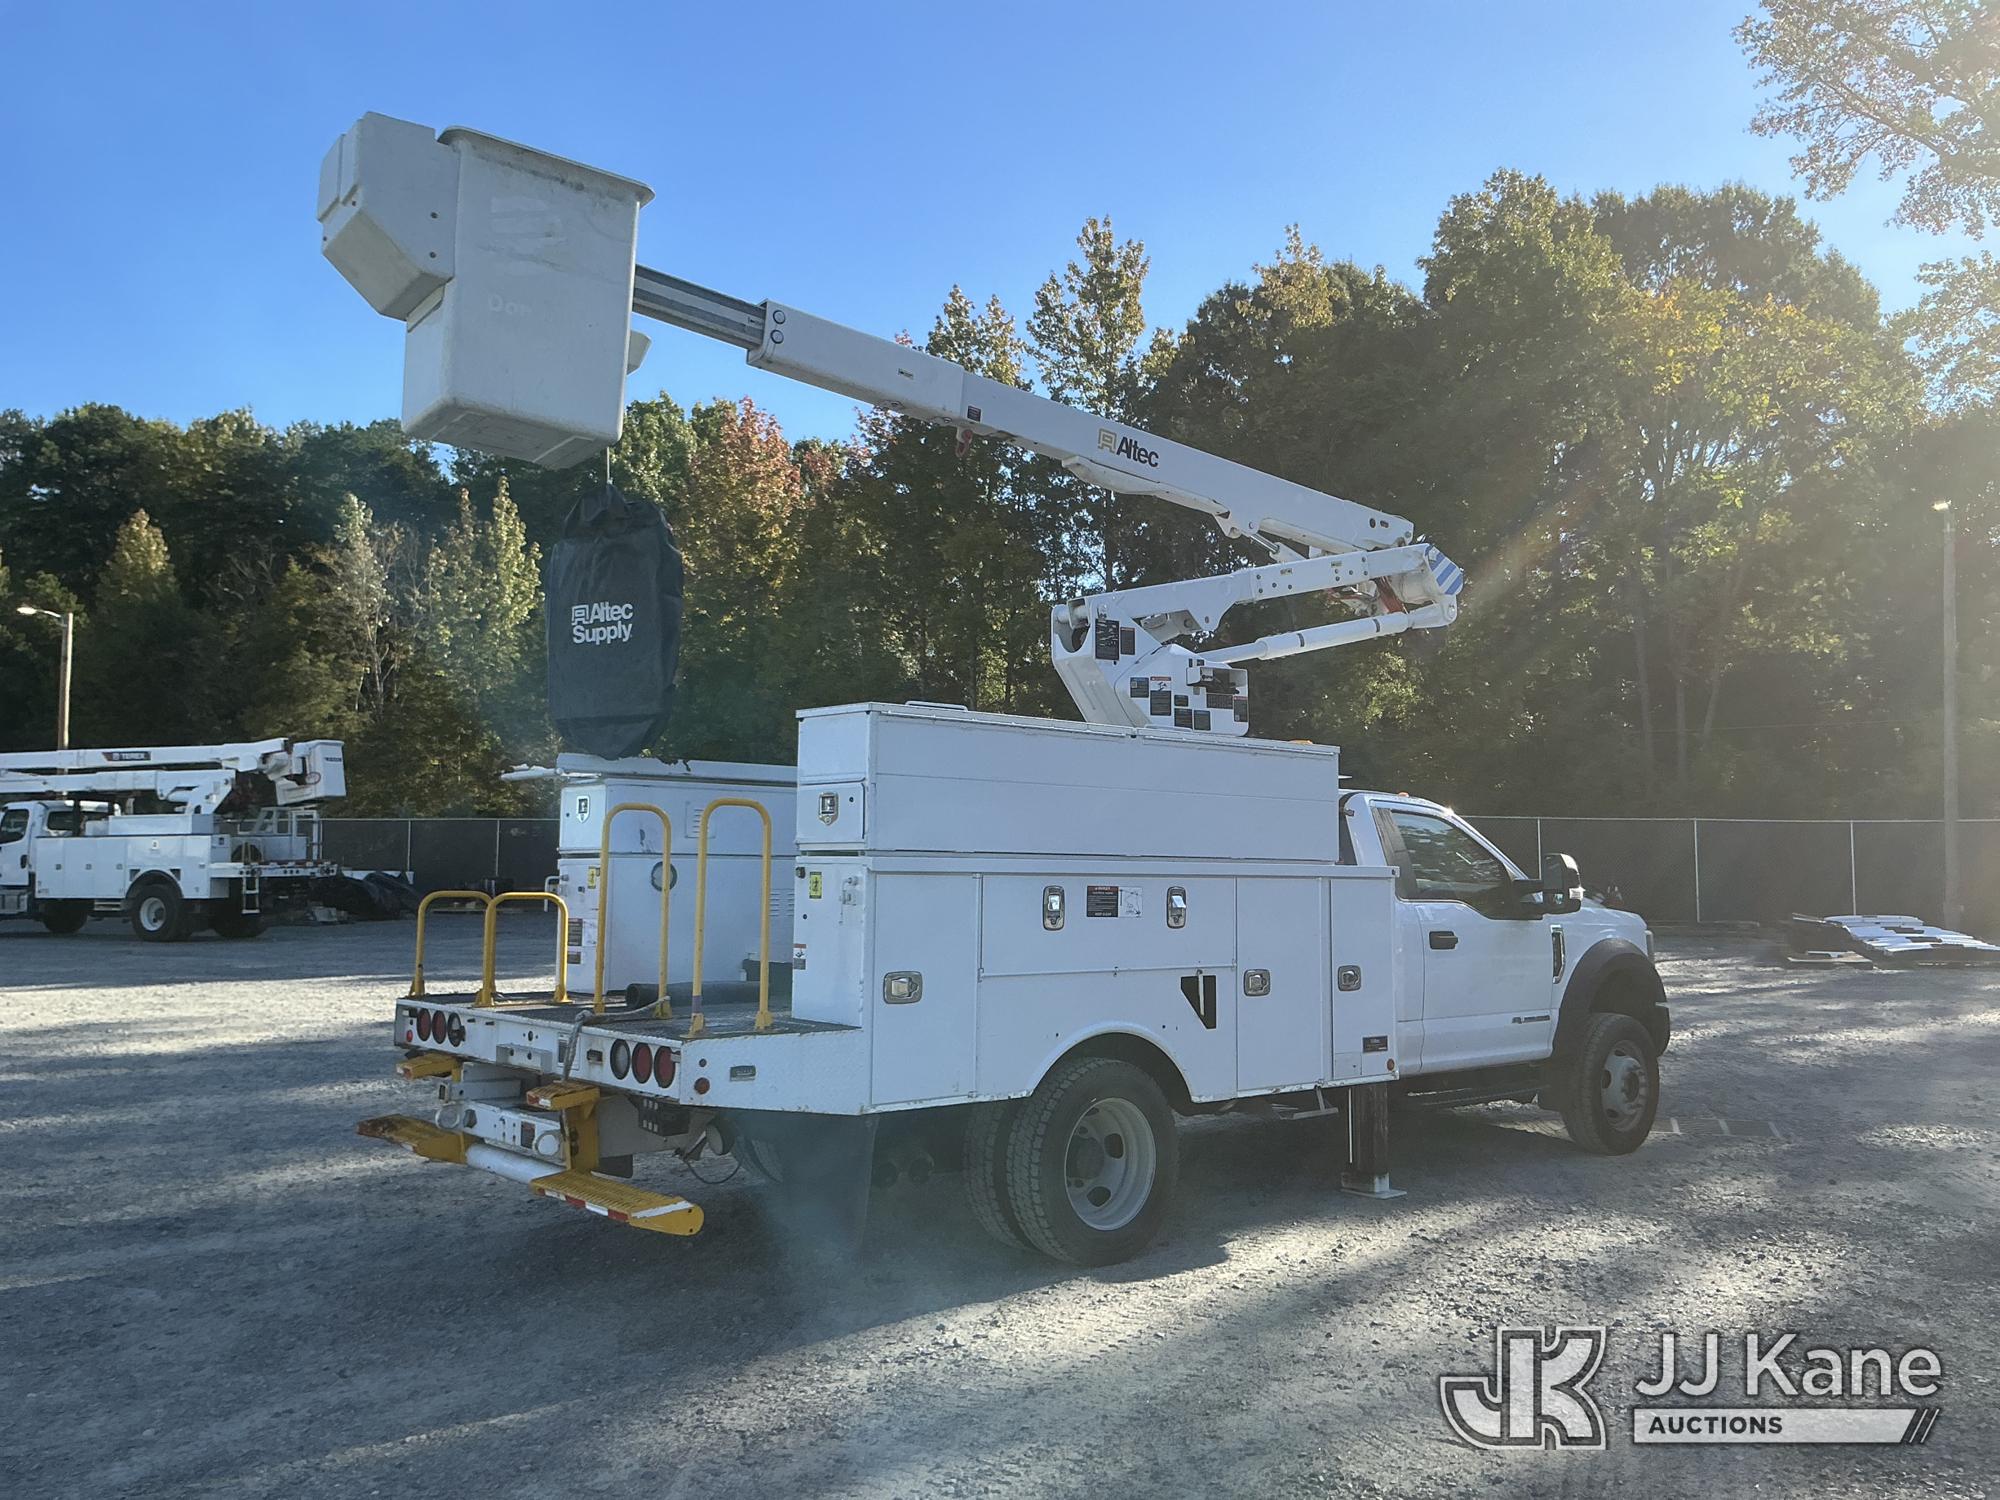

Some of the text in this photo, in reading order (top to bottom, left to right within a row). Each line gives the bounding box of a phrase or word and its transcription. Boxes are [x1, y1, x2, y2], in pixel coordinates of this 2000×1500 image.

[1116, 436, 1159, 468] Altec
[588, 601, 634, 624] Altec
[572, 620, 633, 645] Supply
